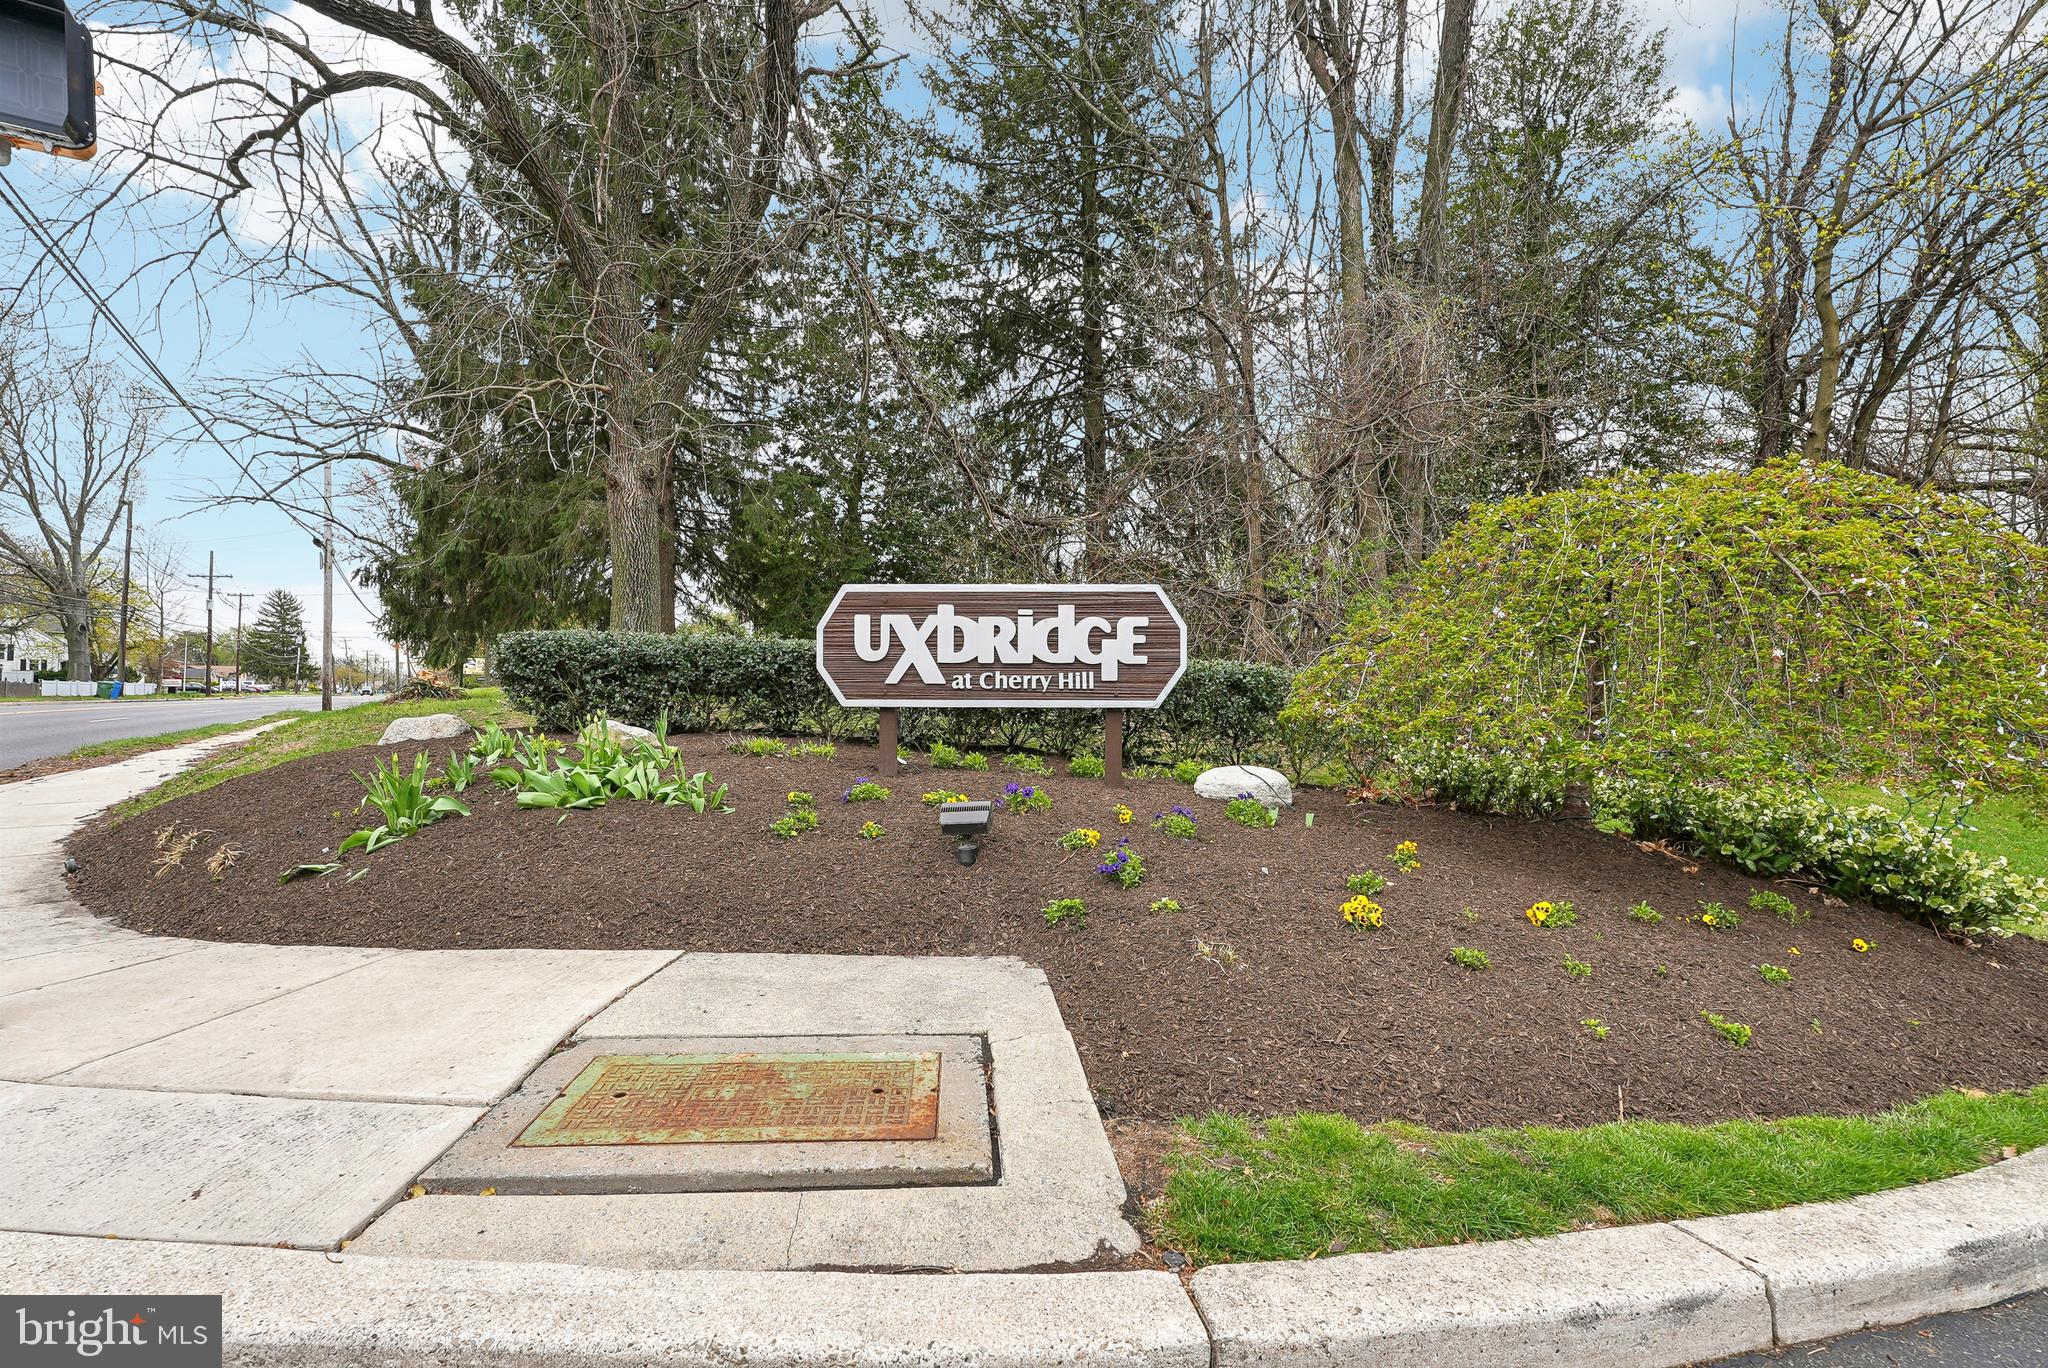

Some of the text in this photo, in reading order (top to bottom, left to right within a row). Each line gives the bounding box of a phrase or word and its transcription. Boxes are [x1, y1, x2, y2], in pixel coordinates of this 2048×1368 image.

[951, 671, 1095, 692] at Cherry Hill
